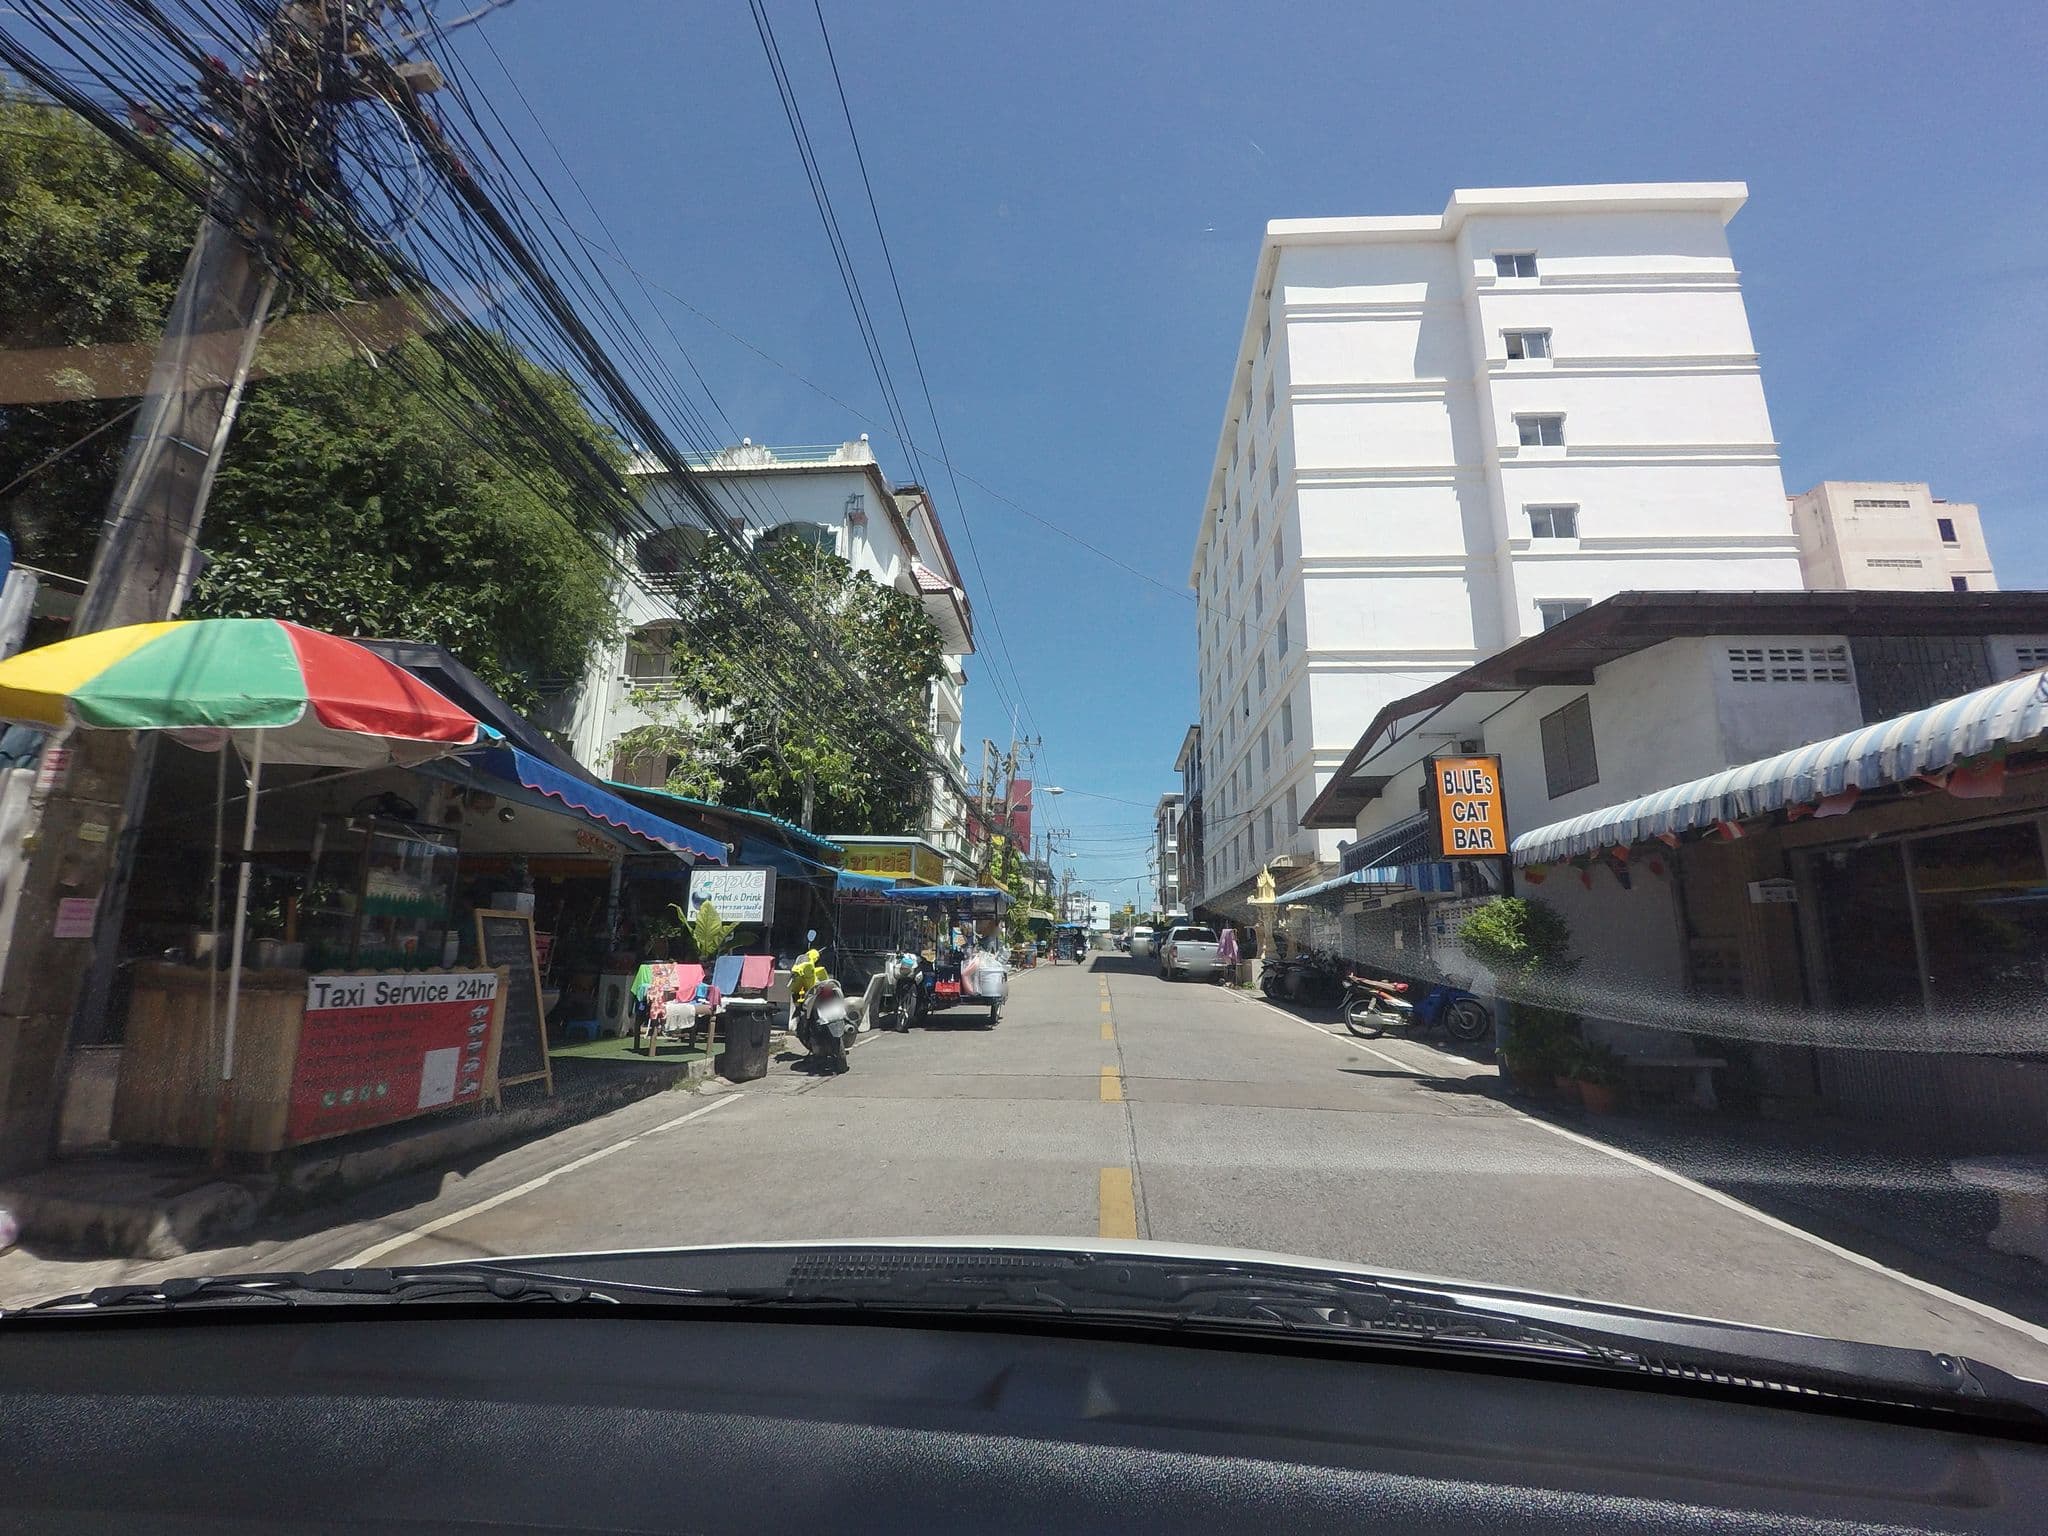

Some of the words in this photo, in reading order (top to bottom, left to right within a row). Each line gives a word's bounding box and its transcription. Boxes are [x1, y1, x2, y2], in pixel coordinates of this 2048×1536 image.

[1452, 801, 1490, 823] CAT
[1453, 827, 1495, 850] BAR
[692, 871, 764, 892] Apple
[714, 893, 732, 902] Food
[740, 893, 762, 902] Drink
[315, 982, 365, 1008] Taxi
[375, 981, 449, 1005] Service
[455, 978, 495, 1000] 24hr
